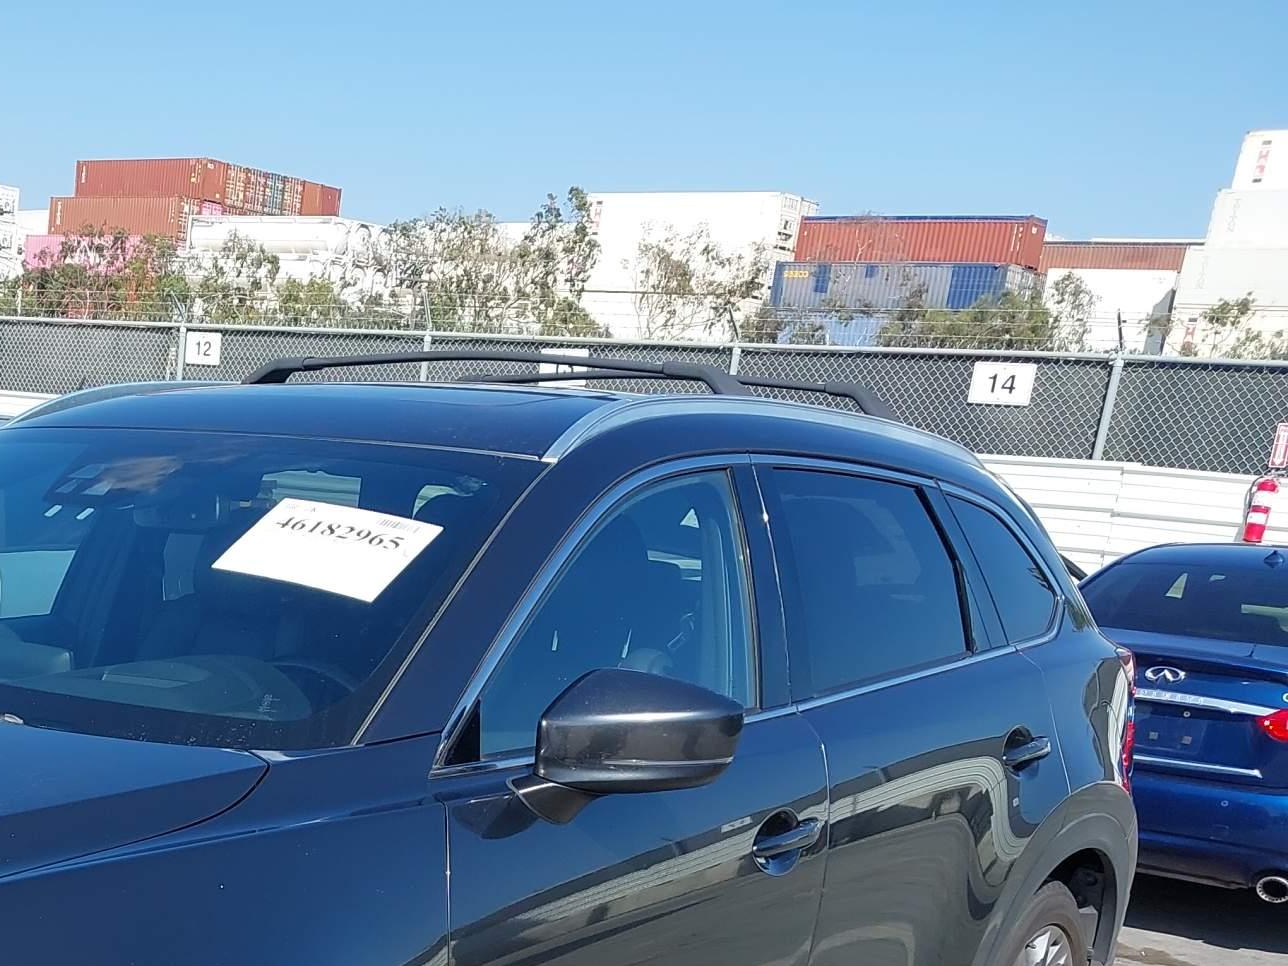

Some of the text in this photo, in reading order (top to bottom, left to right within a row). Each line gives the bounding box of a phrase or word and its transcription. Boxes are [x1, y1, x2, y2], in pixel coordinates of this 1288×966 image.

[196, 340, 212, 357] 12
[988, 373, 1017, 395] 14
[276, 516, 405, 550] 46182965
